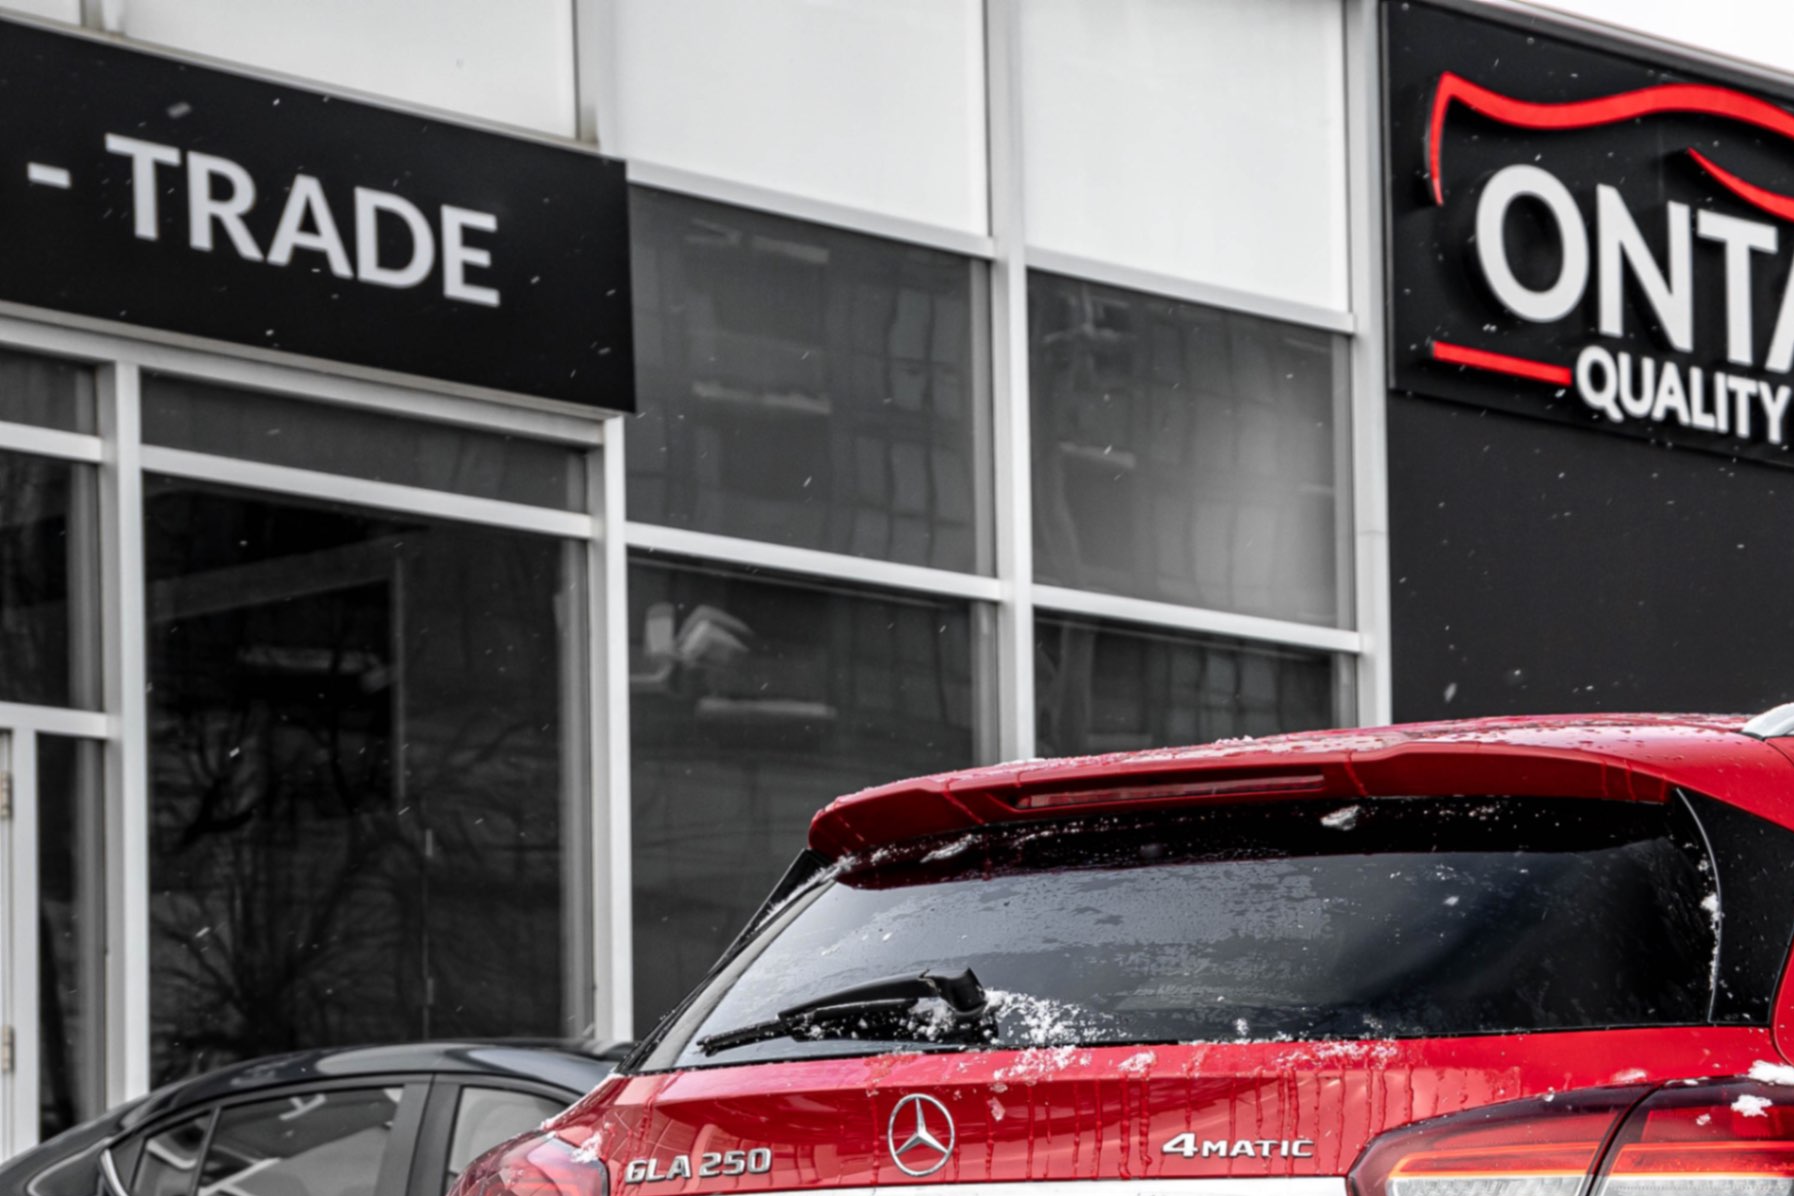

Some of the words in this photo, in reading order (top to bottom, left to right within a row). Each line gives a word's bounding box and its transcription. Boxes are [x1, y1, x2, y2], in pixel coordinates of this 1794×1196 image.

[105, 133, 500, 306] TRADE
[1575, 345, 1792, 445] QUALITY
[624, 1154, 692, 1185] GLA
[699, 1146, 772, 1178] 250
[1162, 1131, 1315, 1159] 4MATIC
